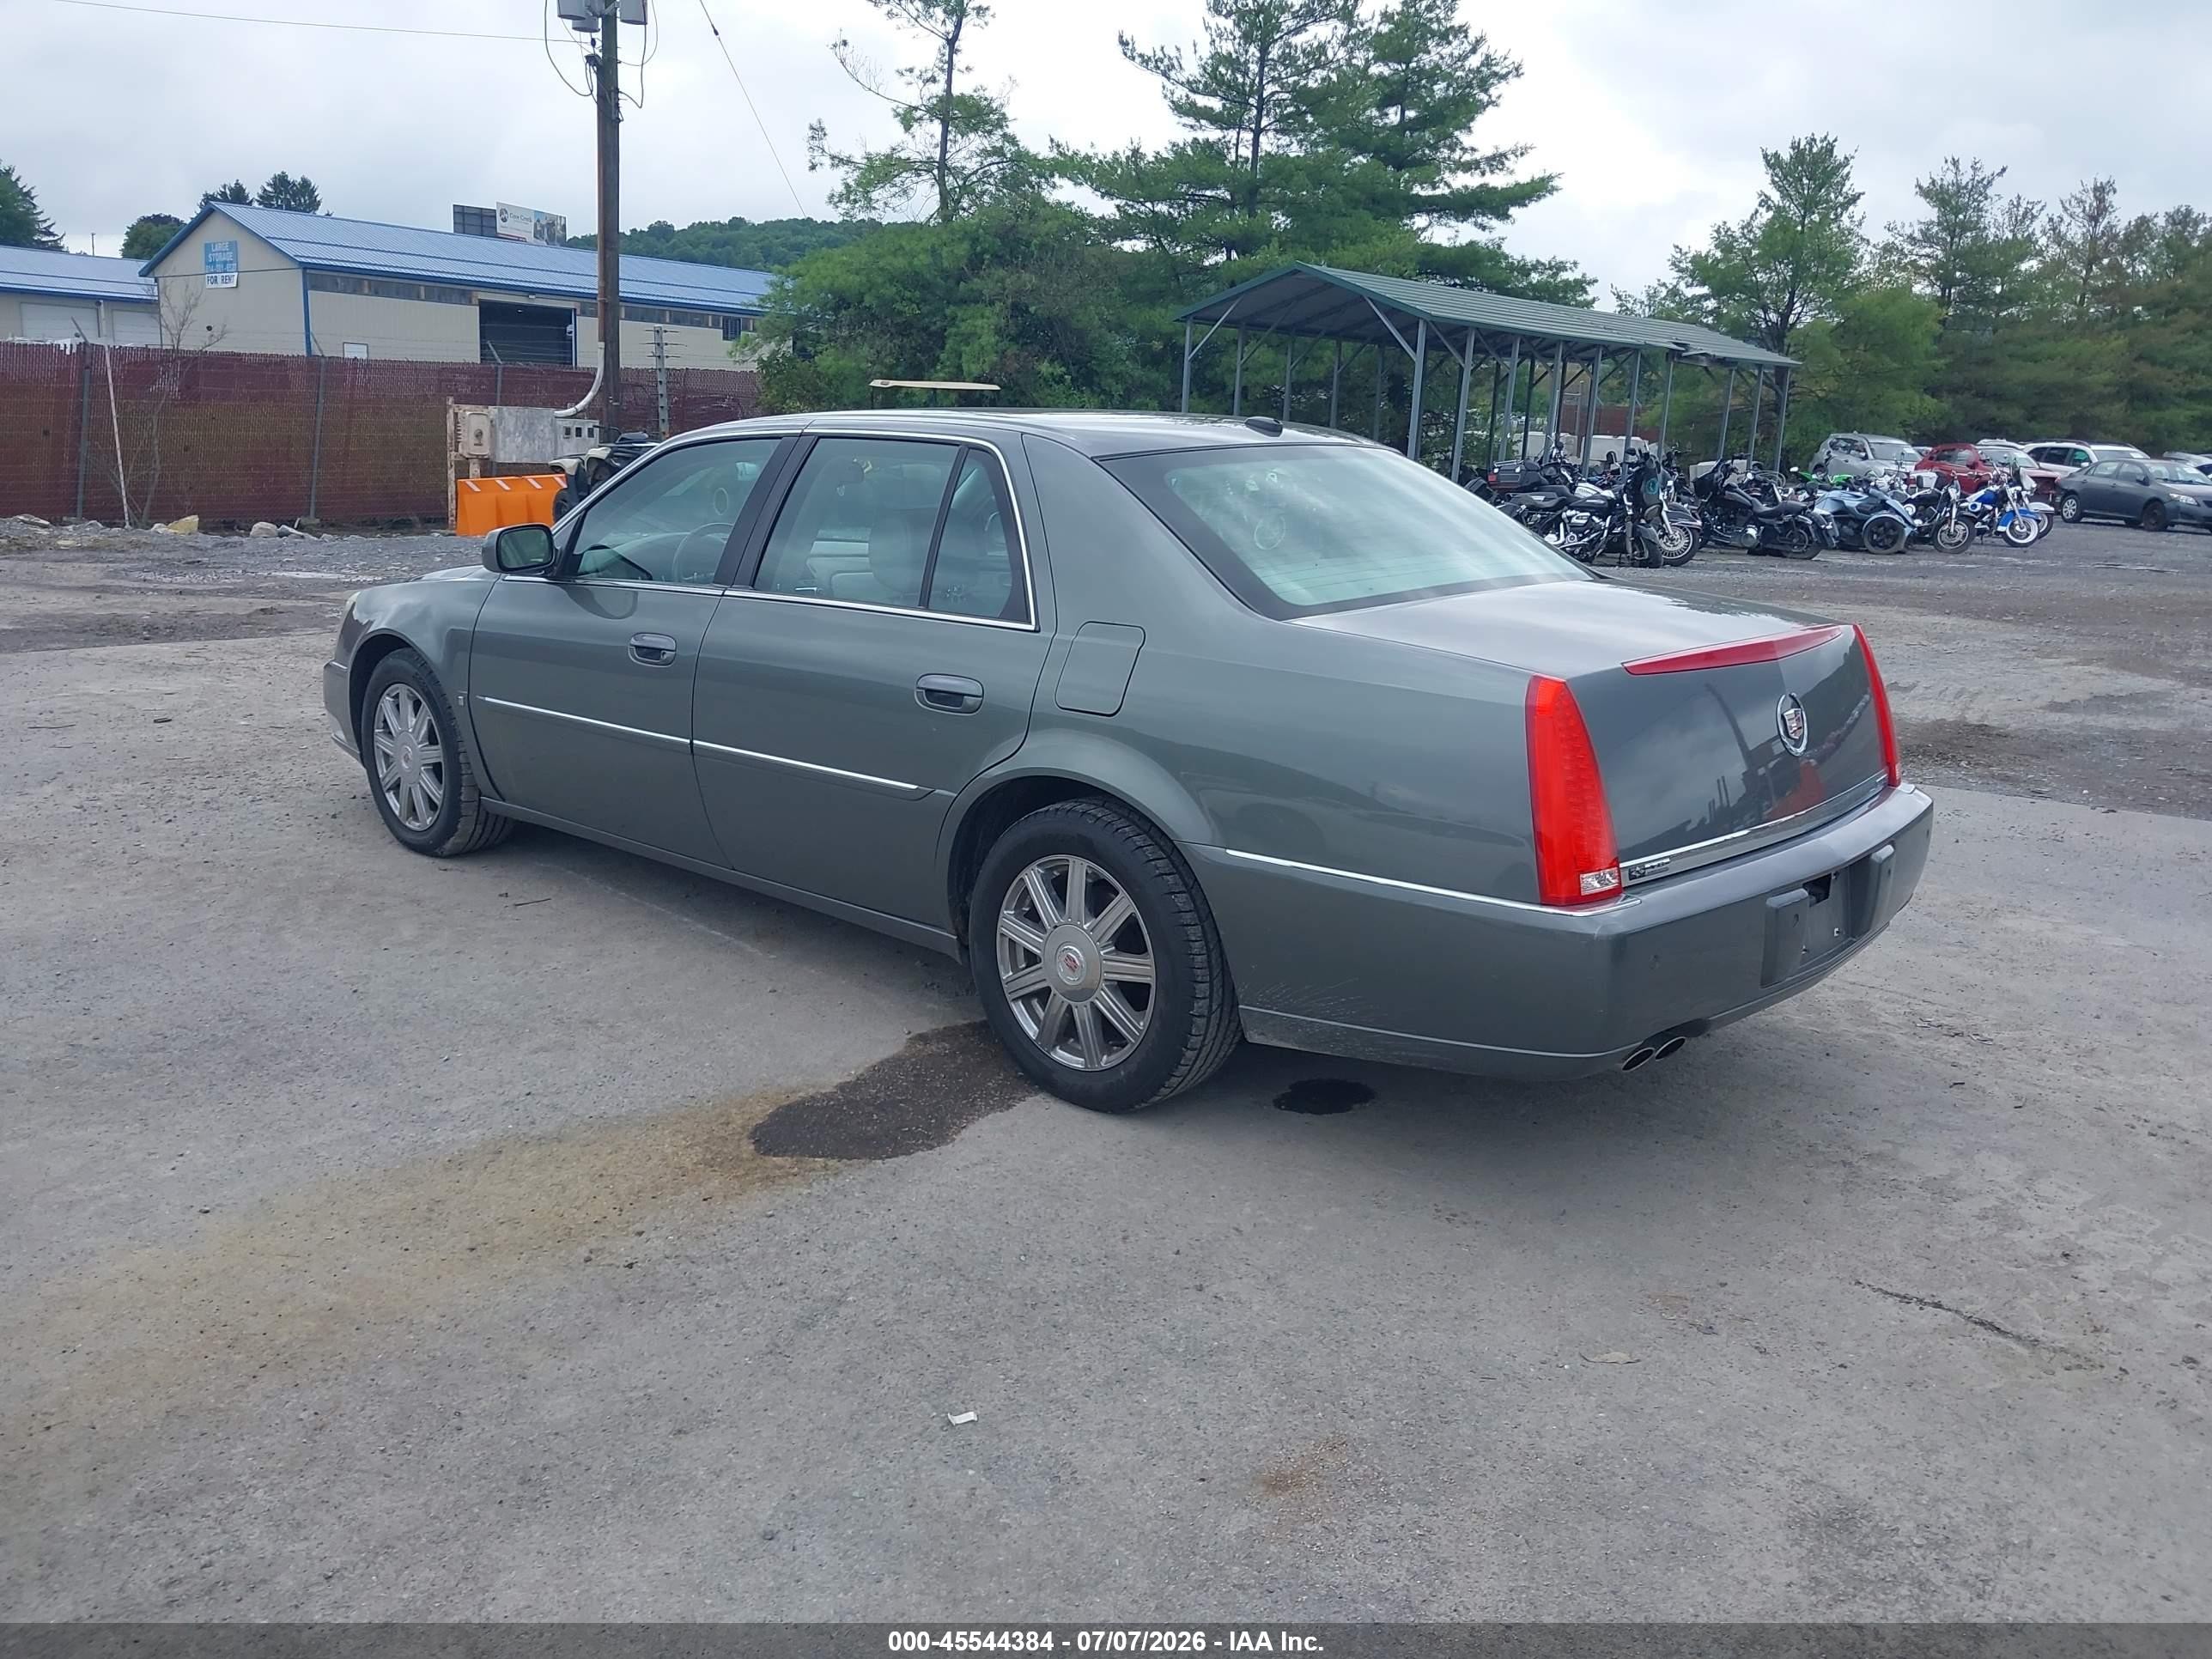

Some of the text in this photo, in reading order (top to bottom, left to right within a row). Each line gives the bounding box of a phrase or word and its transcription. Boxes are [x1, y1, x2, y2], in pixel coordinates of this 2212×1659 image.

[208, 252, 234, 262] STORAGE
[206, 275, 235, 285] FOR RENT
